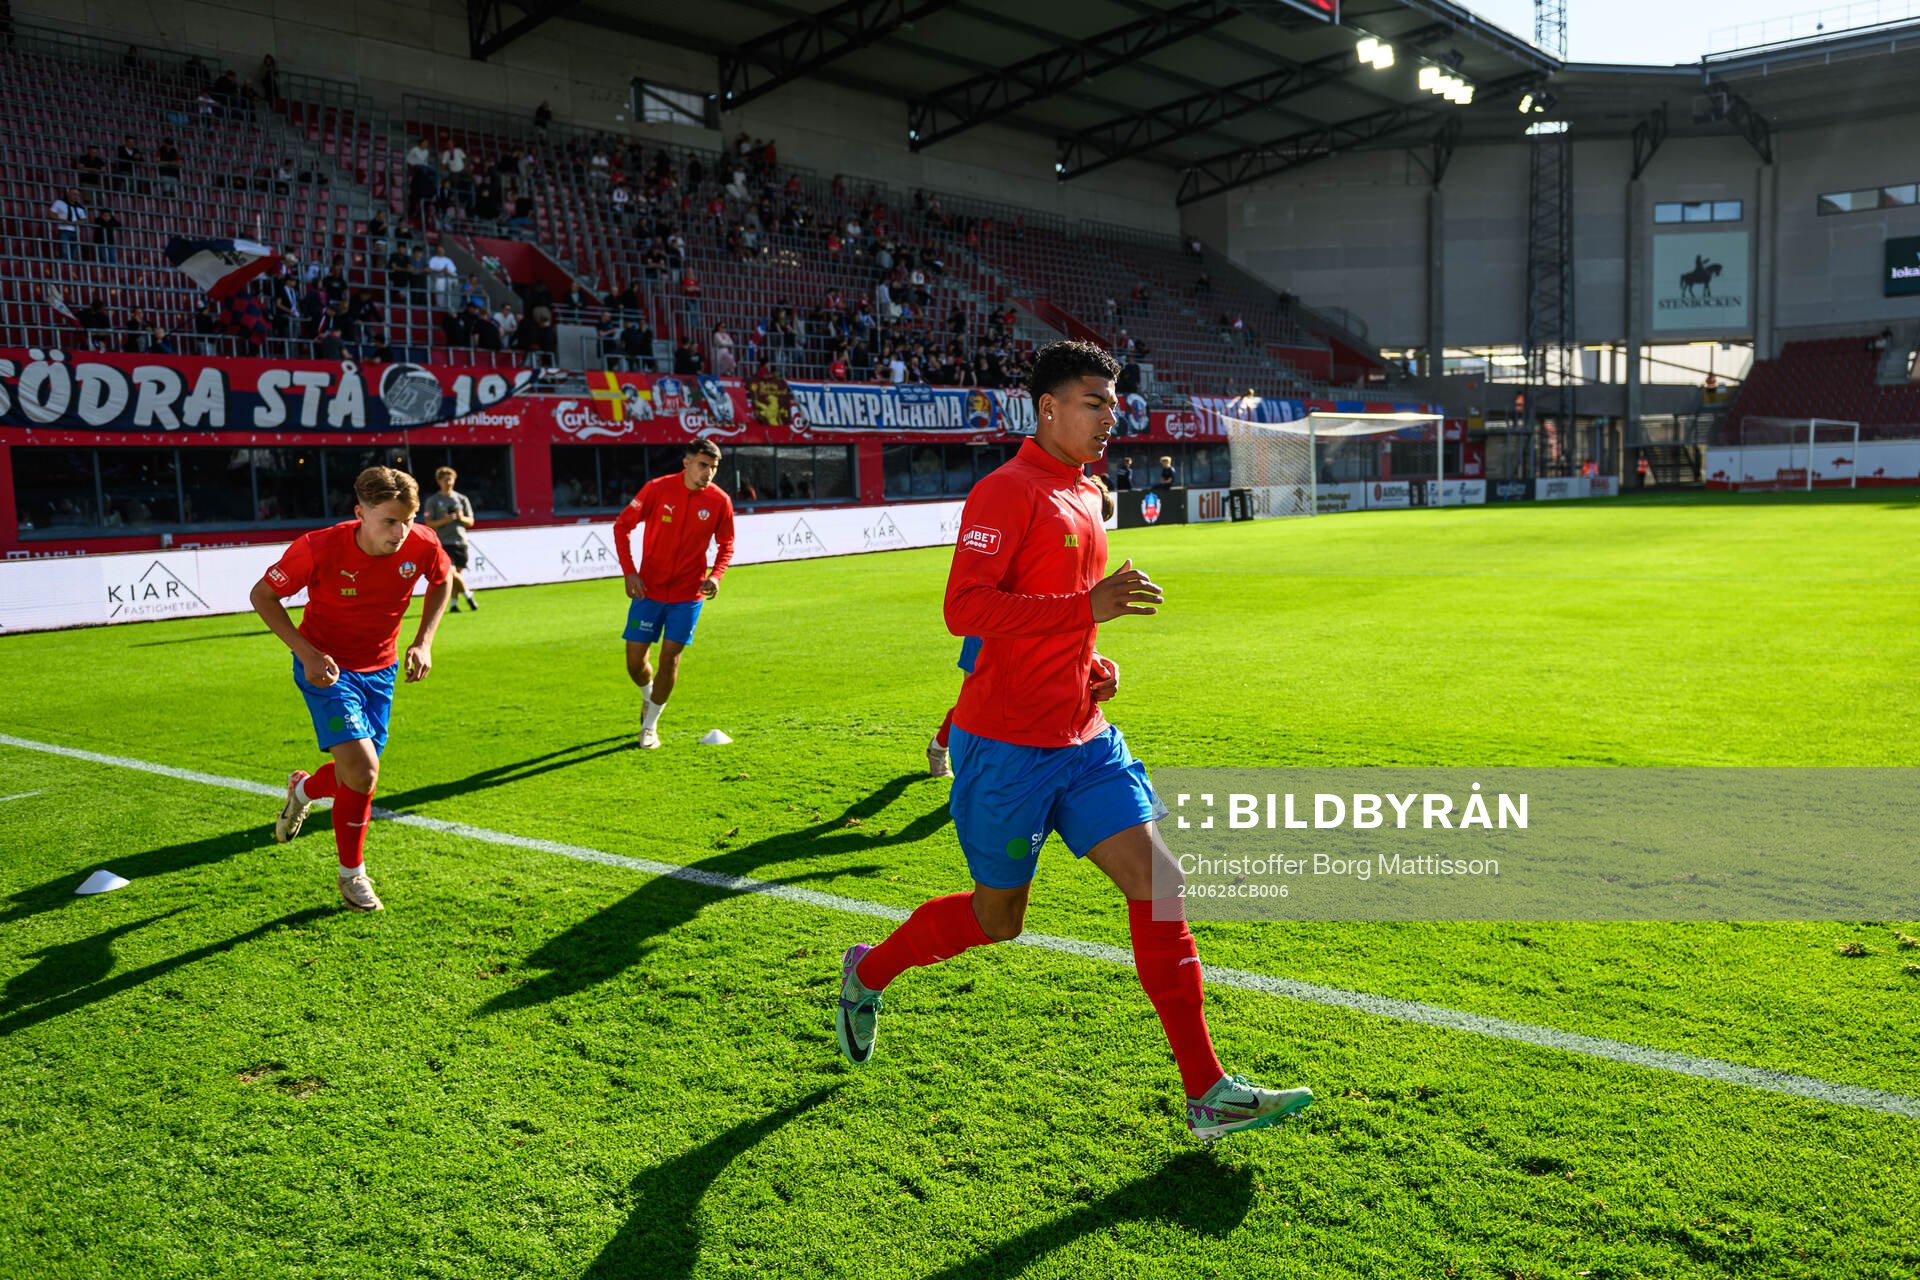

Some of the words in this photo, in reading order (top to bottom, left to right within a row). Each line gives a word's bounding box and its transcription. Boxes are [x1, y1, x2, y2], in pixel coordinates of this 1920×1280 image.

[1658, 296, 1742, 310] STENBOCKEN
[254, 360, 367, 428] STÅ
[777, 531, 813, 546] KIAR
[863, 525, 896, 538] KIAR
[1064, 534, 1079, 547] XXL
[561, 547, 608, 565] KIAR
[107, 580, 181, 603] KIAR
[123, 601, 200, 616] FASTIGHETER
